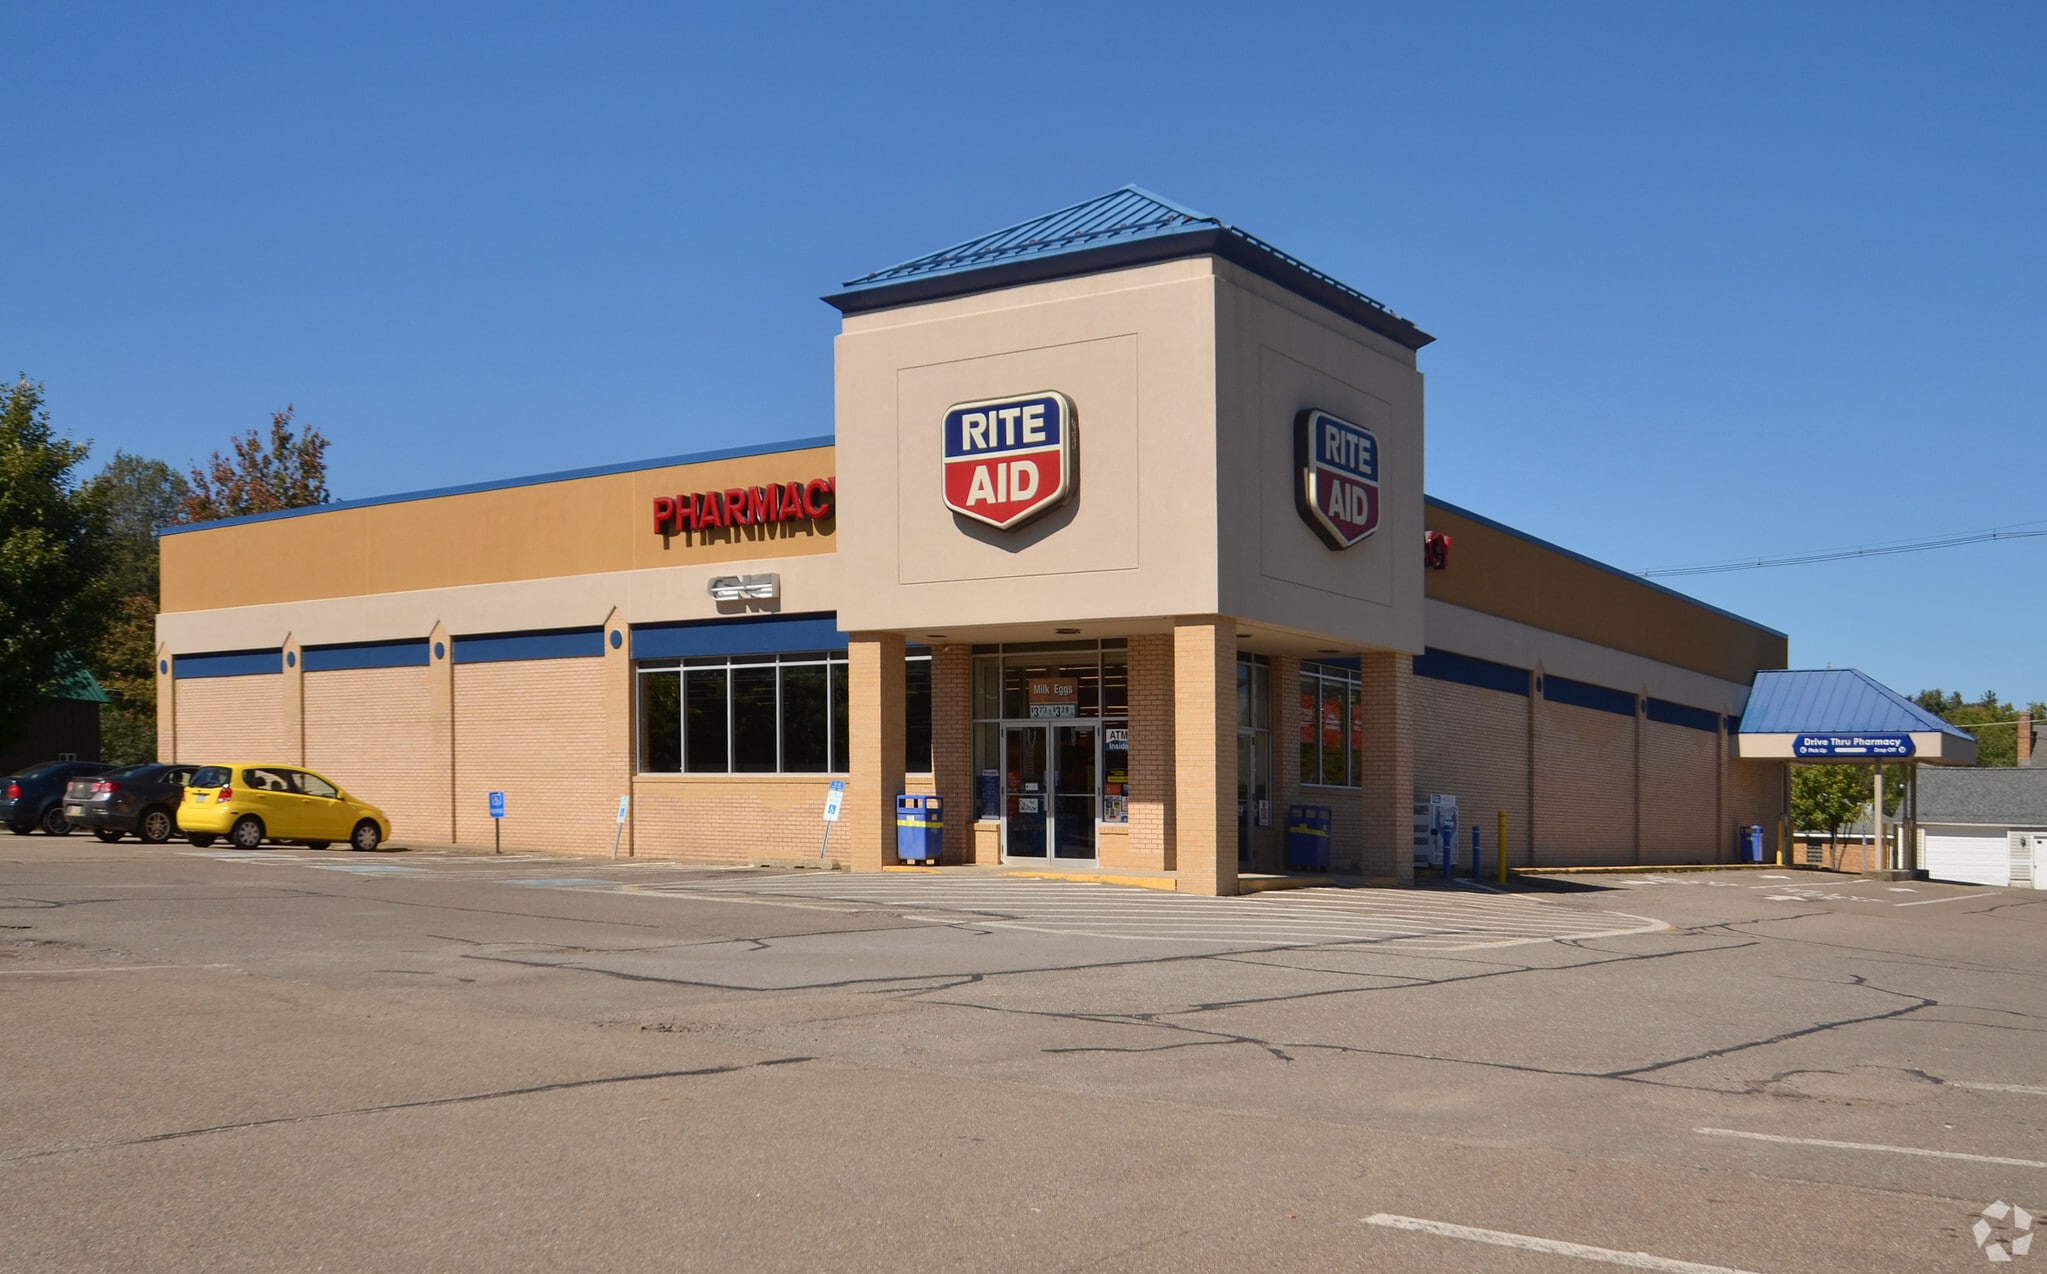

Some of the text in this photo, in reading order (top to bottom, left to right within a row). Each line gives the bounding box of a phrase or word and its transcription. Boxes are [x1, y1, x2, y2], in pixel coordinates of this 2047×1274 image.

[961, 404, 1046, 451] RITE
[1325, 424, 1372, 475] RITE
[965, 460, 1039, 506] AID
[1328, 479, 1369, 525] AID
[1033, 684, 1073, 696] Milk Eggs
[1110, 730, 1128, 740] ATM
[1804, 737, 1902, 747] Drive Thru Pharmacy
